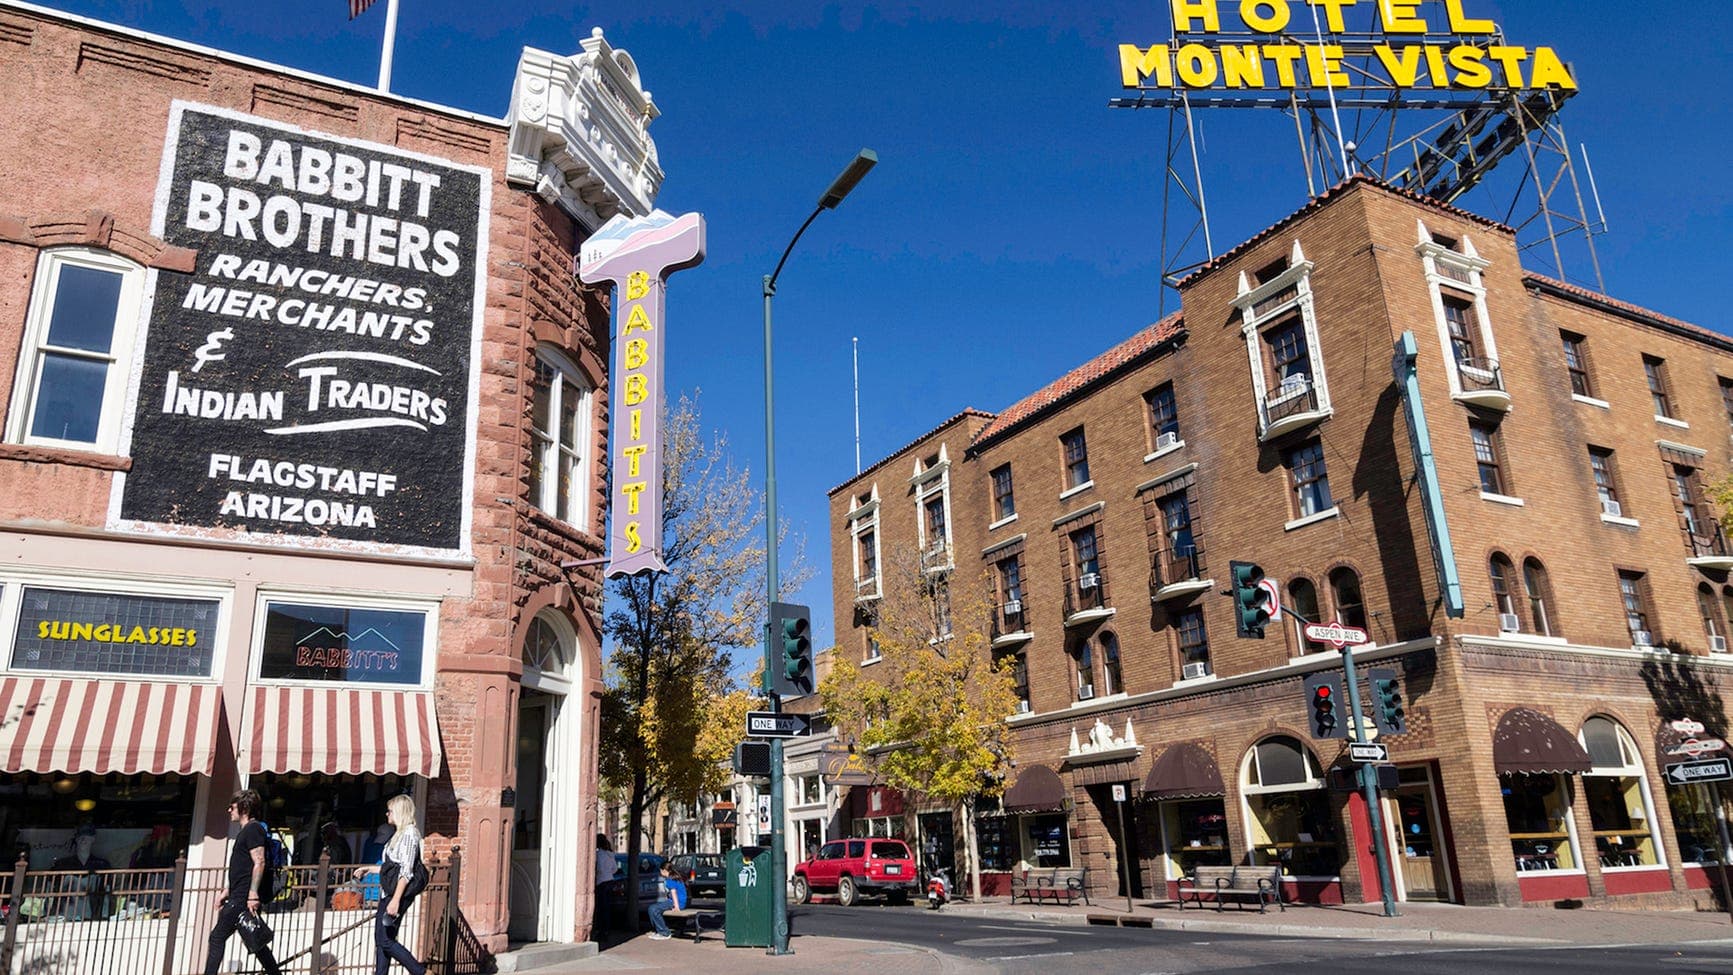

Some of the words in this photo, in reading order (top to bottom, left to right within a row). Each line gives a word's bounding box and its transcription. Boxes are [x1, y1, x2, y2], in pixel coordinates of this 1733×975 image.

[1173, 0, 1496, 33] HOTEL
[1118, 43, 1350, 88] MONTE
[1373, 43, 1579, 90] VISTA
[223, 128, 441, 218] BABBITT
[185, 179, 460, 278] BROTHERS
[207, 253, 433, 314] RANCHERS,
[181, 282, 435, 346] MERCHANTS
[191, 326, 235, 373] &
[162, 370, 284, 421] INDIAN
[298, 366, 448, 426] TRADERS
[622, 270, 653, 554] BABBITTS
[208, 453, 397, 498] FLAGSTAFF
[217, 490, 378, 530] ARIZONA
[37, 619, 198, 648] SUNGLASSES
[1314, 627, 1341, 639] ASPEN
[296, 646, 399, 671] BABBITT'S
[753, 719, 773, 729] ONE
[775, 719, 795, 730] WAY
[1682, 767, 1702, 777] ONE
[1702, 765, 1723, 775] WAY
